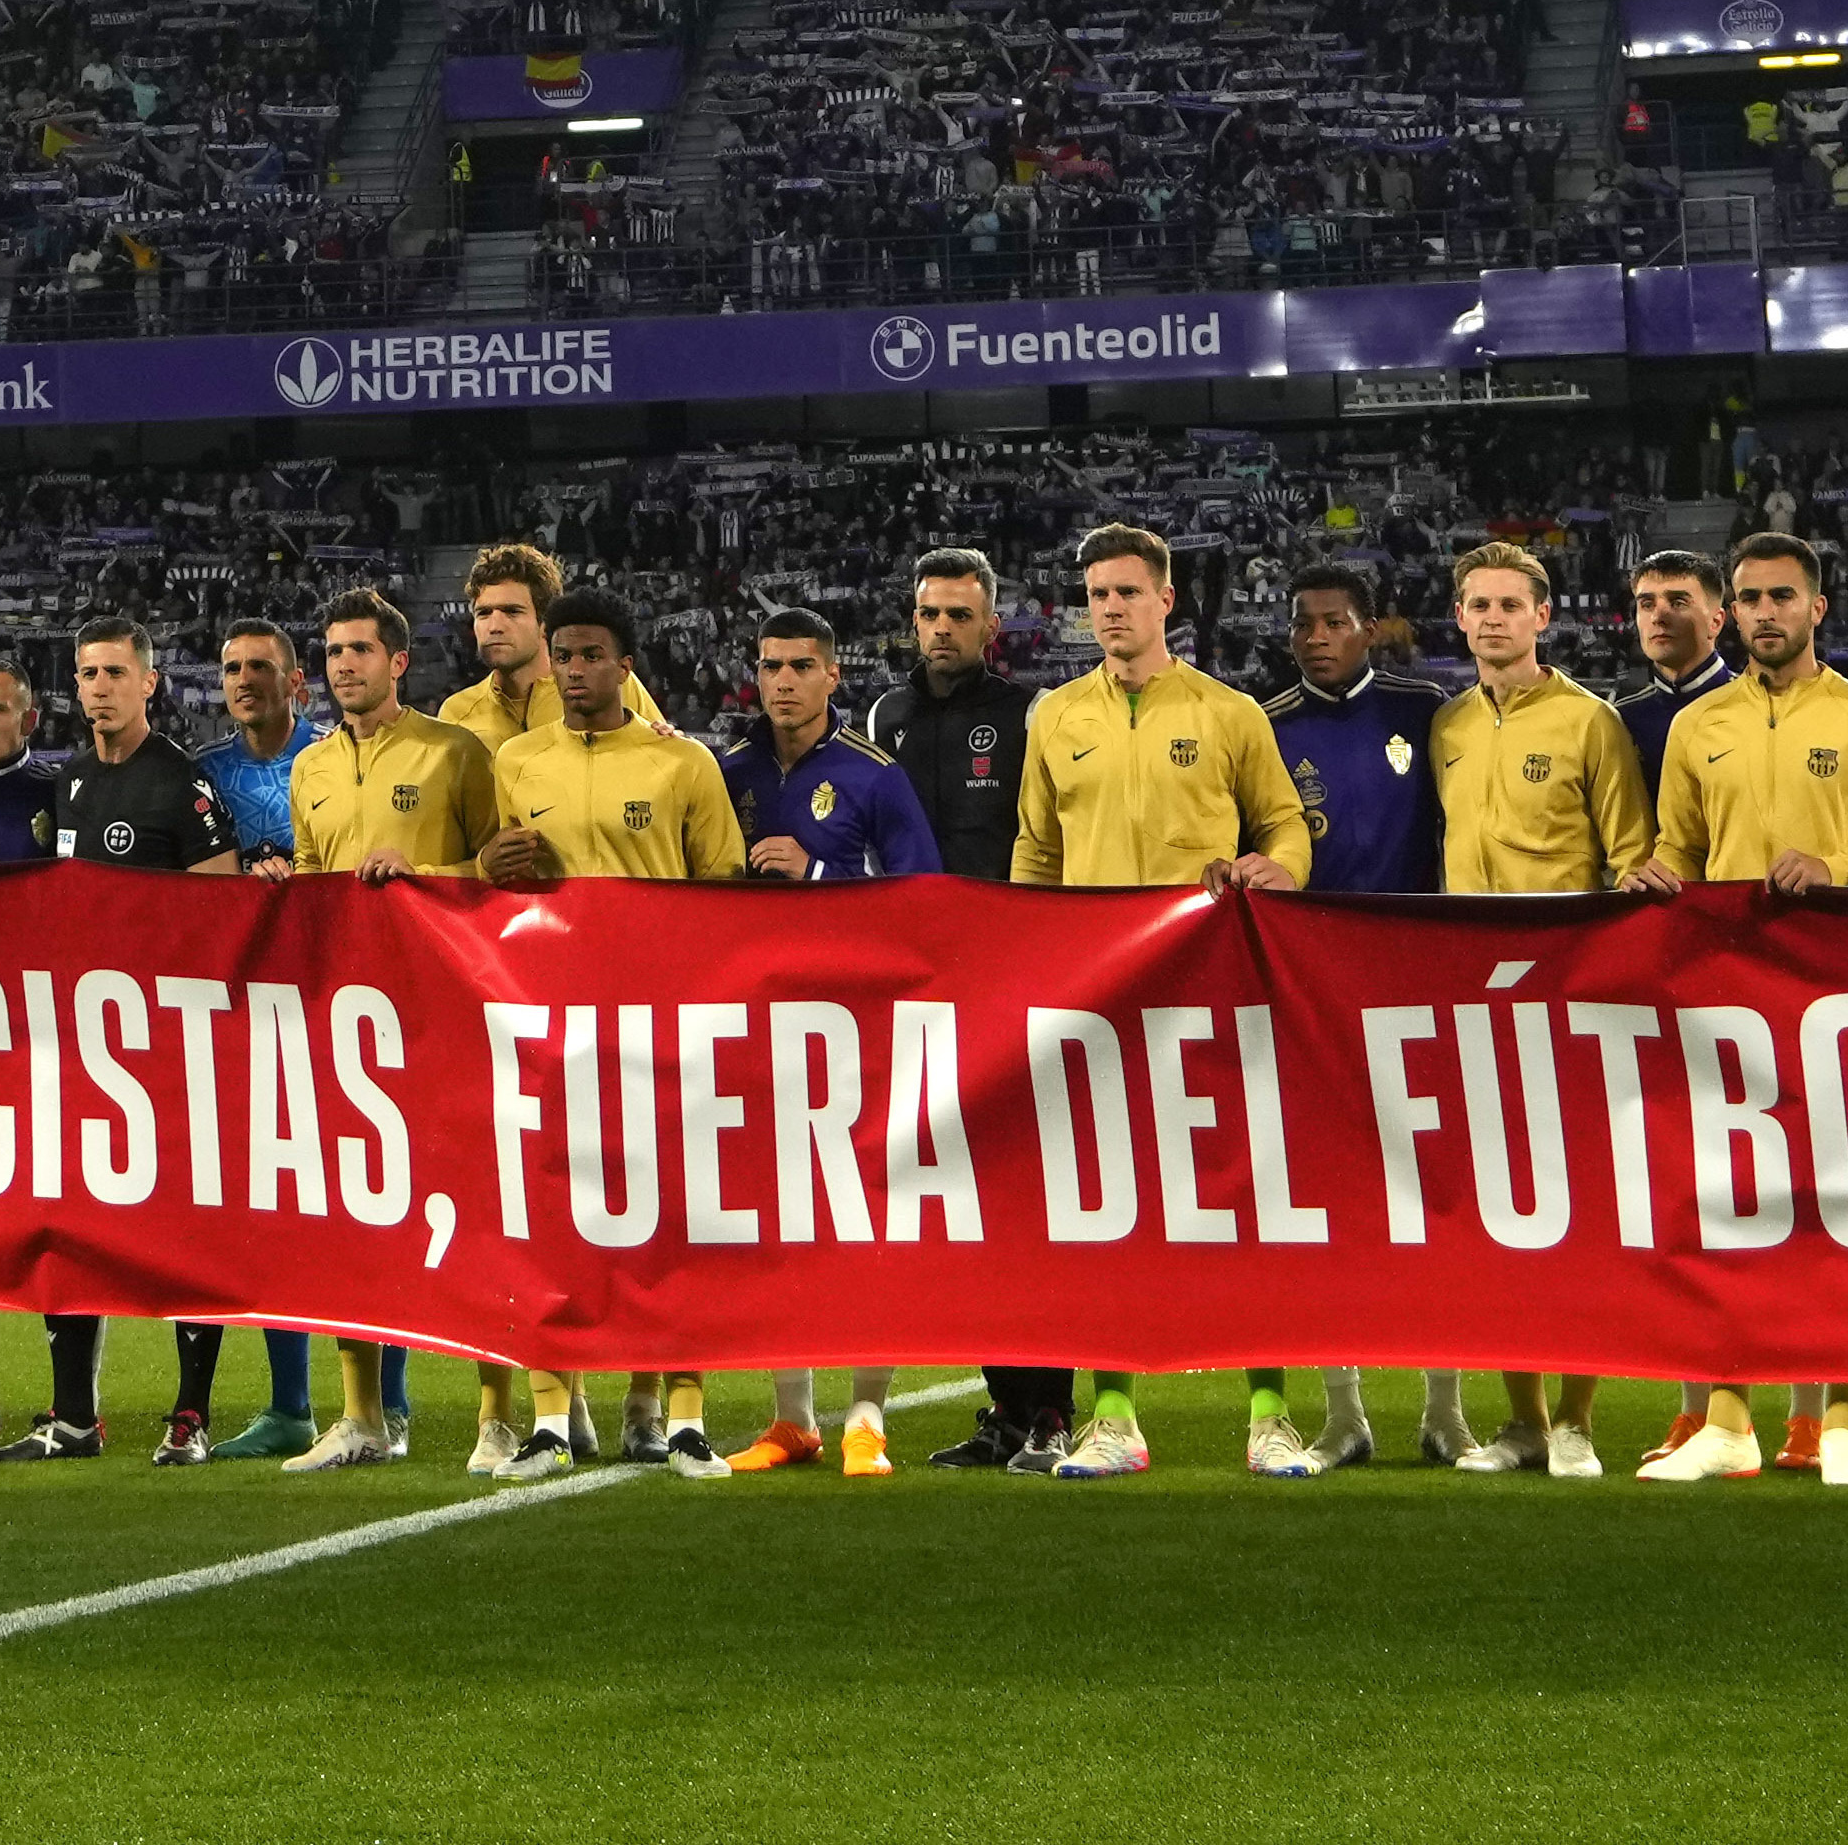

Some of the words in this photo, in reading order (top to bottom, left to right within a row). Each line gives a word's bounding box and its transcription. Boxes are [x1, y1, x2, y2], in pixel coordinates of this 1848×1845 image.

[1728, 7, 1776, 22] Estrella
[350, 328, 611, 369] HERBALIFE
[947, 312, 1221, 367] Fuenteolid
[350, 362, 612, 402] NUTRITION
[483, 1000, 983, 1248] FUERA
[1026, 1003, 1329, 1243] DEL
